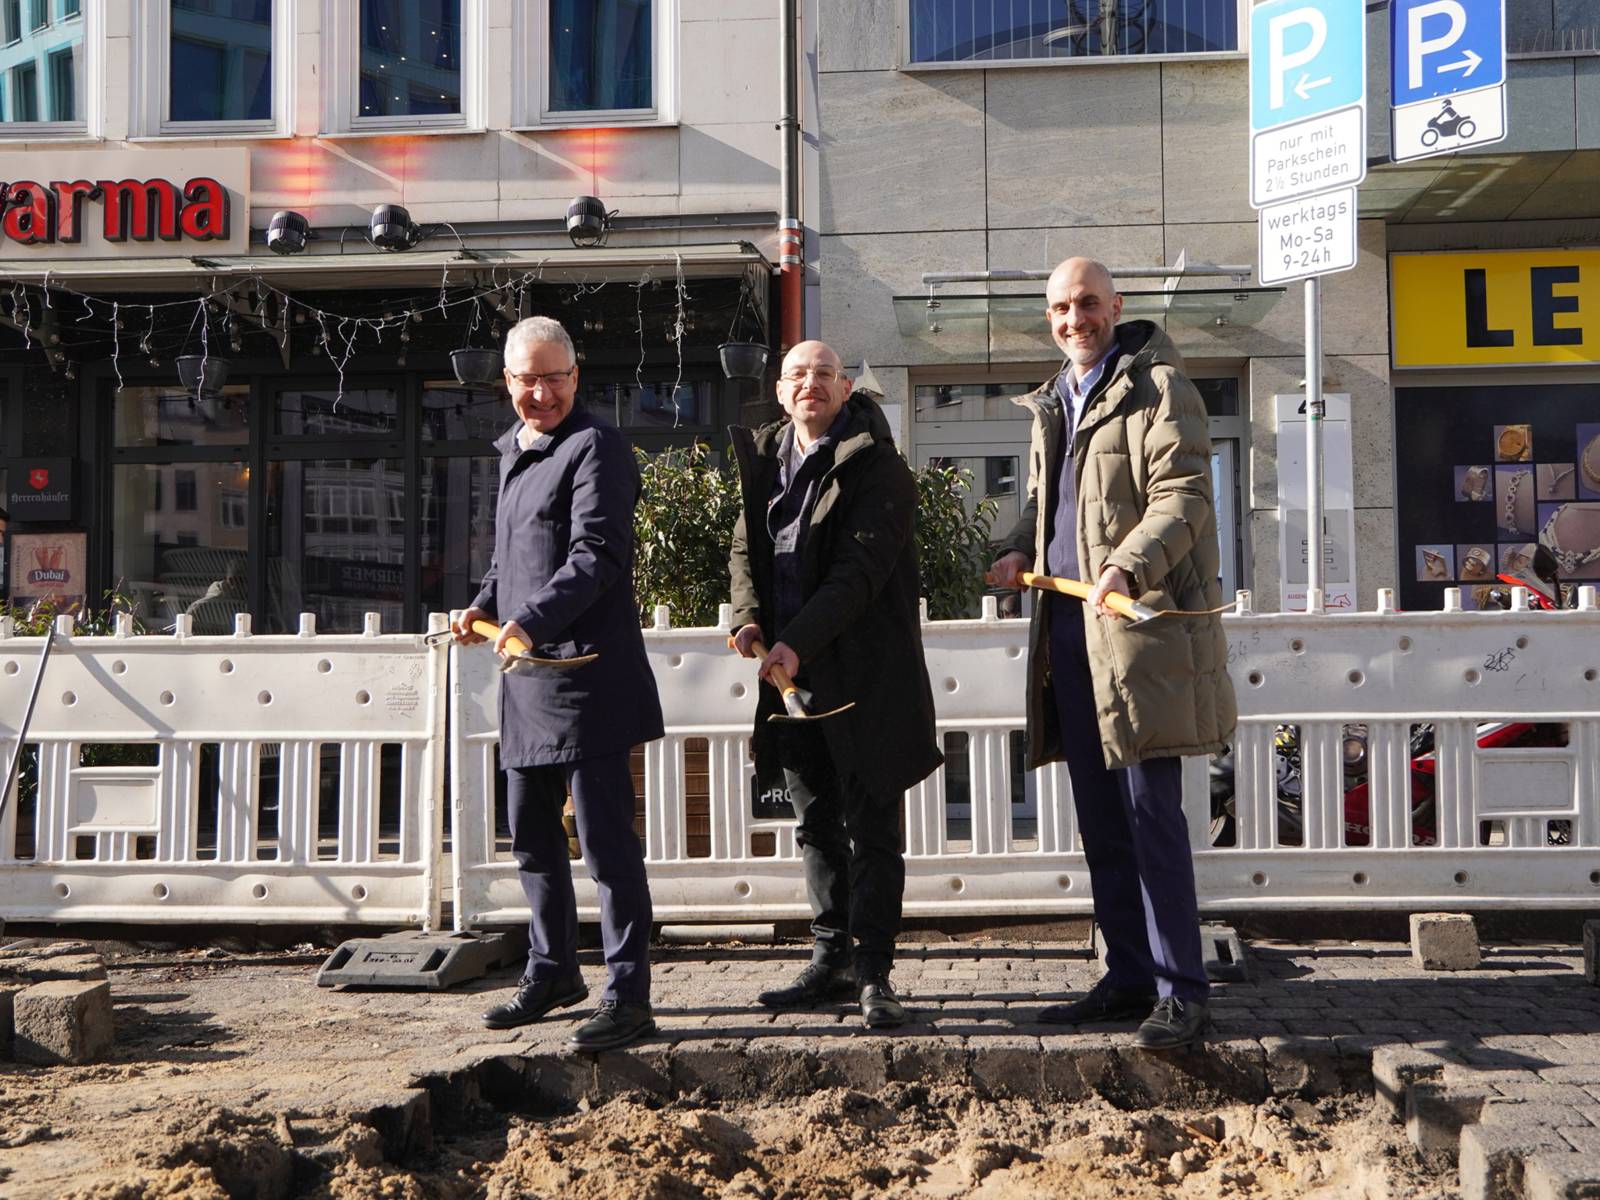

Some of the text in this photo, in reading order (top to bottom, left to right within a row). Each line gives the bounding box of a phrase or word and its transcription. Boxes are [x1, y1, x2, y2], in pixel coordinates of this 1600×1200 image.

[1269, 7, 1328, 110] P
[1408, 0, 1467, 90] P
[1279, 125, 1334, 151] nur mit
[1267, 143, 1347, 174] Parkschein
[1290, 162, 1349, 187] Stunden
[0, 177, 231, 245] arma
[1268, 201, 1347, 231] werktags
[1280, 226, 1334, 250] Mo-Sa
[1464, 266, 1583, 348] LE
[34, 569, 65, 581] Dubai
